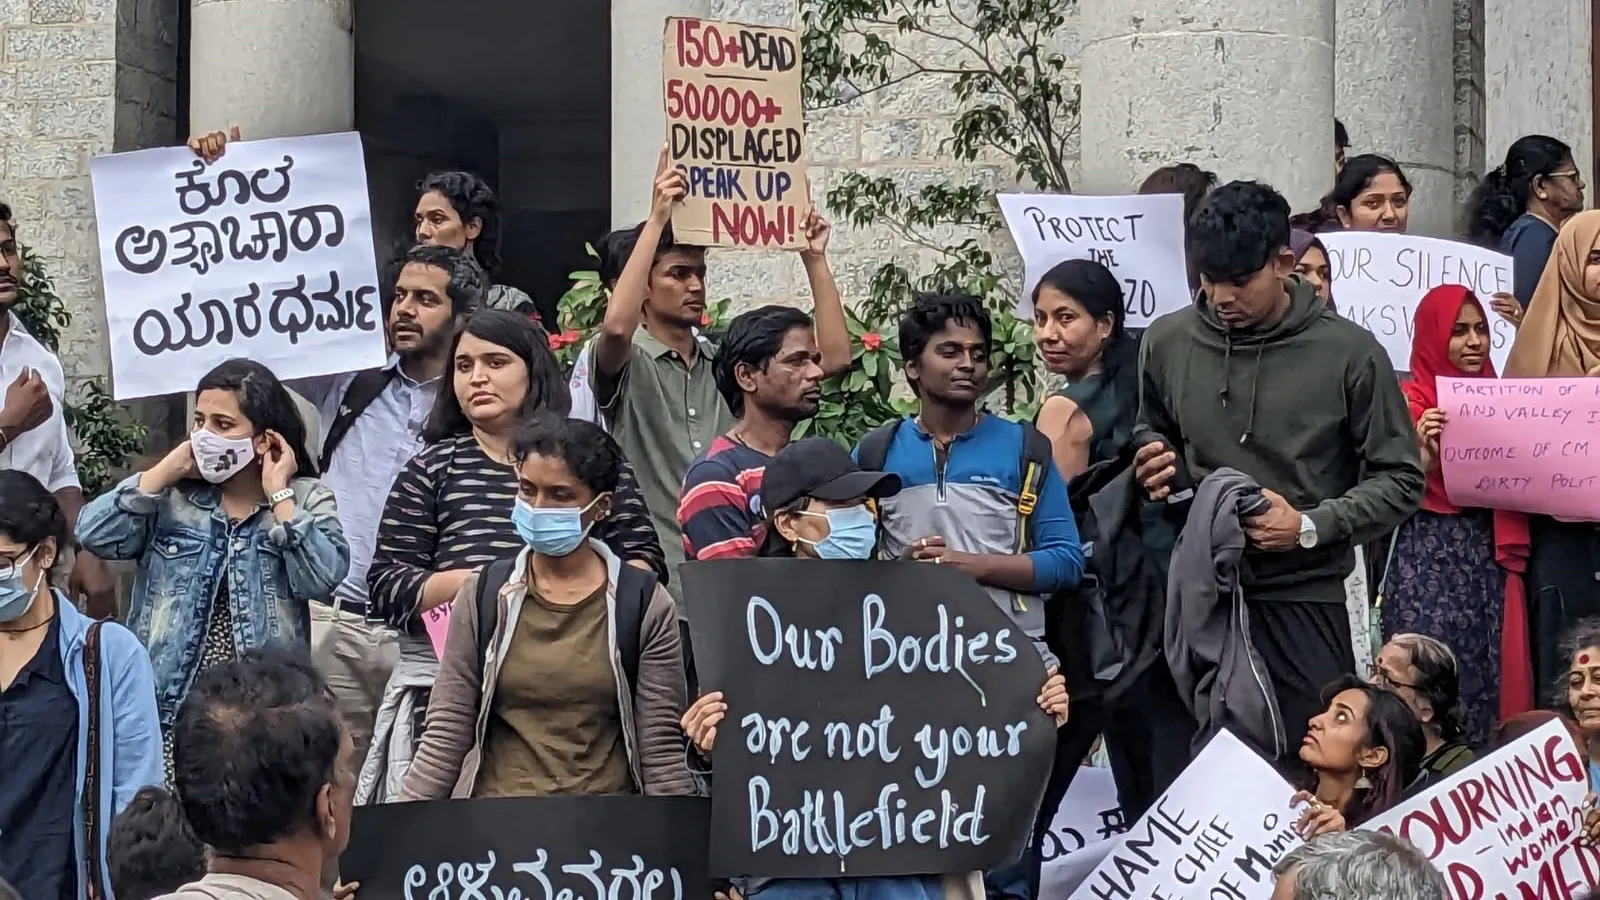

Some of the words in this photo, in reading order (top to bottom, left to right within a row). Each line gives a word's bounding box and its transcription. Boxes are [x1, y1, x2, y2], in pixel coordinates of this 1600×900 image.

[667, 79, 782, 128] 50000+
[672, 123, 801, 166] DISPLACED
[756, 171, 792, 202] UP
[712, 202, 795, 246] NOW!
[1023, 206, 1144, 244] PROTECT
[1087, 248, 1119, 269] THE
[1328, 244, 1378, 283] OUR
[1389, 247, 1508, 295] SILENCE
[1451, 382, 1544, 396] PARTITION
[1558, 384, 1577, 396] OF
[1459, 403, 1496, 418] AND
[1504, 407, 1572, 425] VALLEY
[1444, 446, 1517, 462] OUTCOME
[1532, 442, 1552, 458] OF
[1561, 441, 1588, 457] CM
[1475, 476, 1531, 491] DIRTY
[747, 596, 843, 672] Our
[863, 593, 1018, 680] Bodies
[741, 712, 812, 762] are
[823, 704, 902, 763] not
[914, 721, 1028, 789] your
[748, 775, 992, 856] Battlefield
[1380, 735, 1585, 862] OURNING
[1090, 794, 1200, 900] HAME
